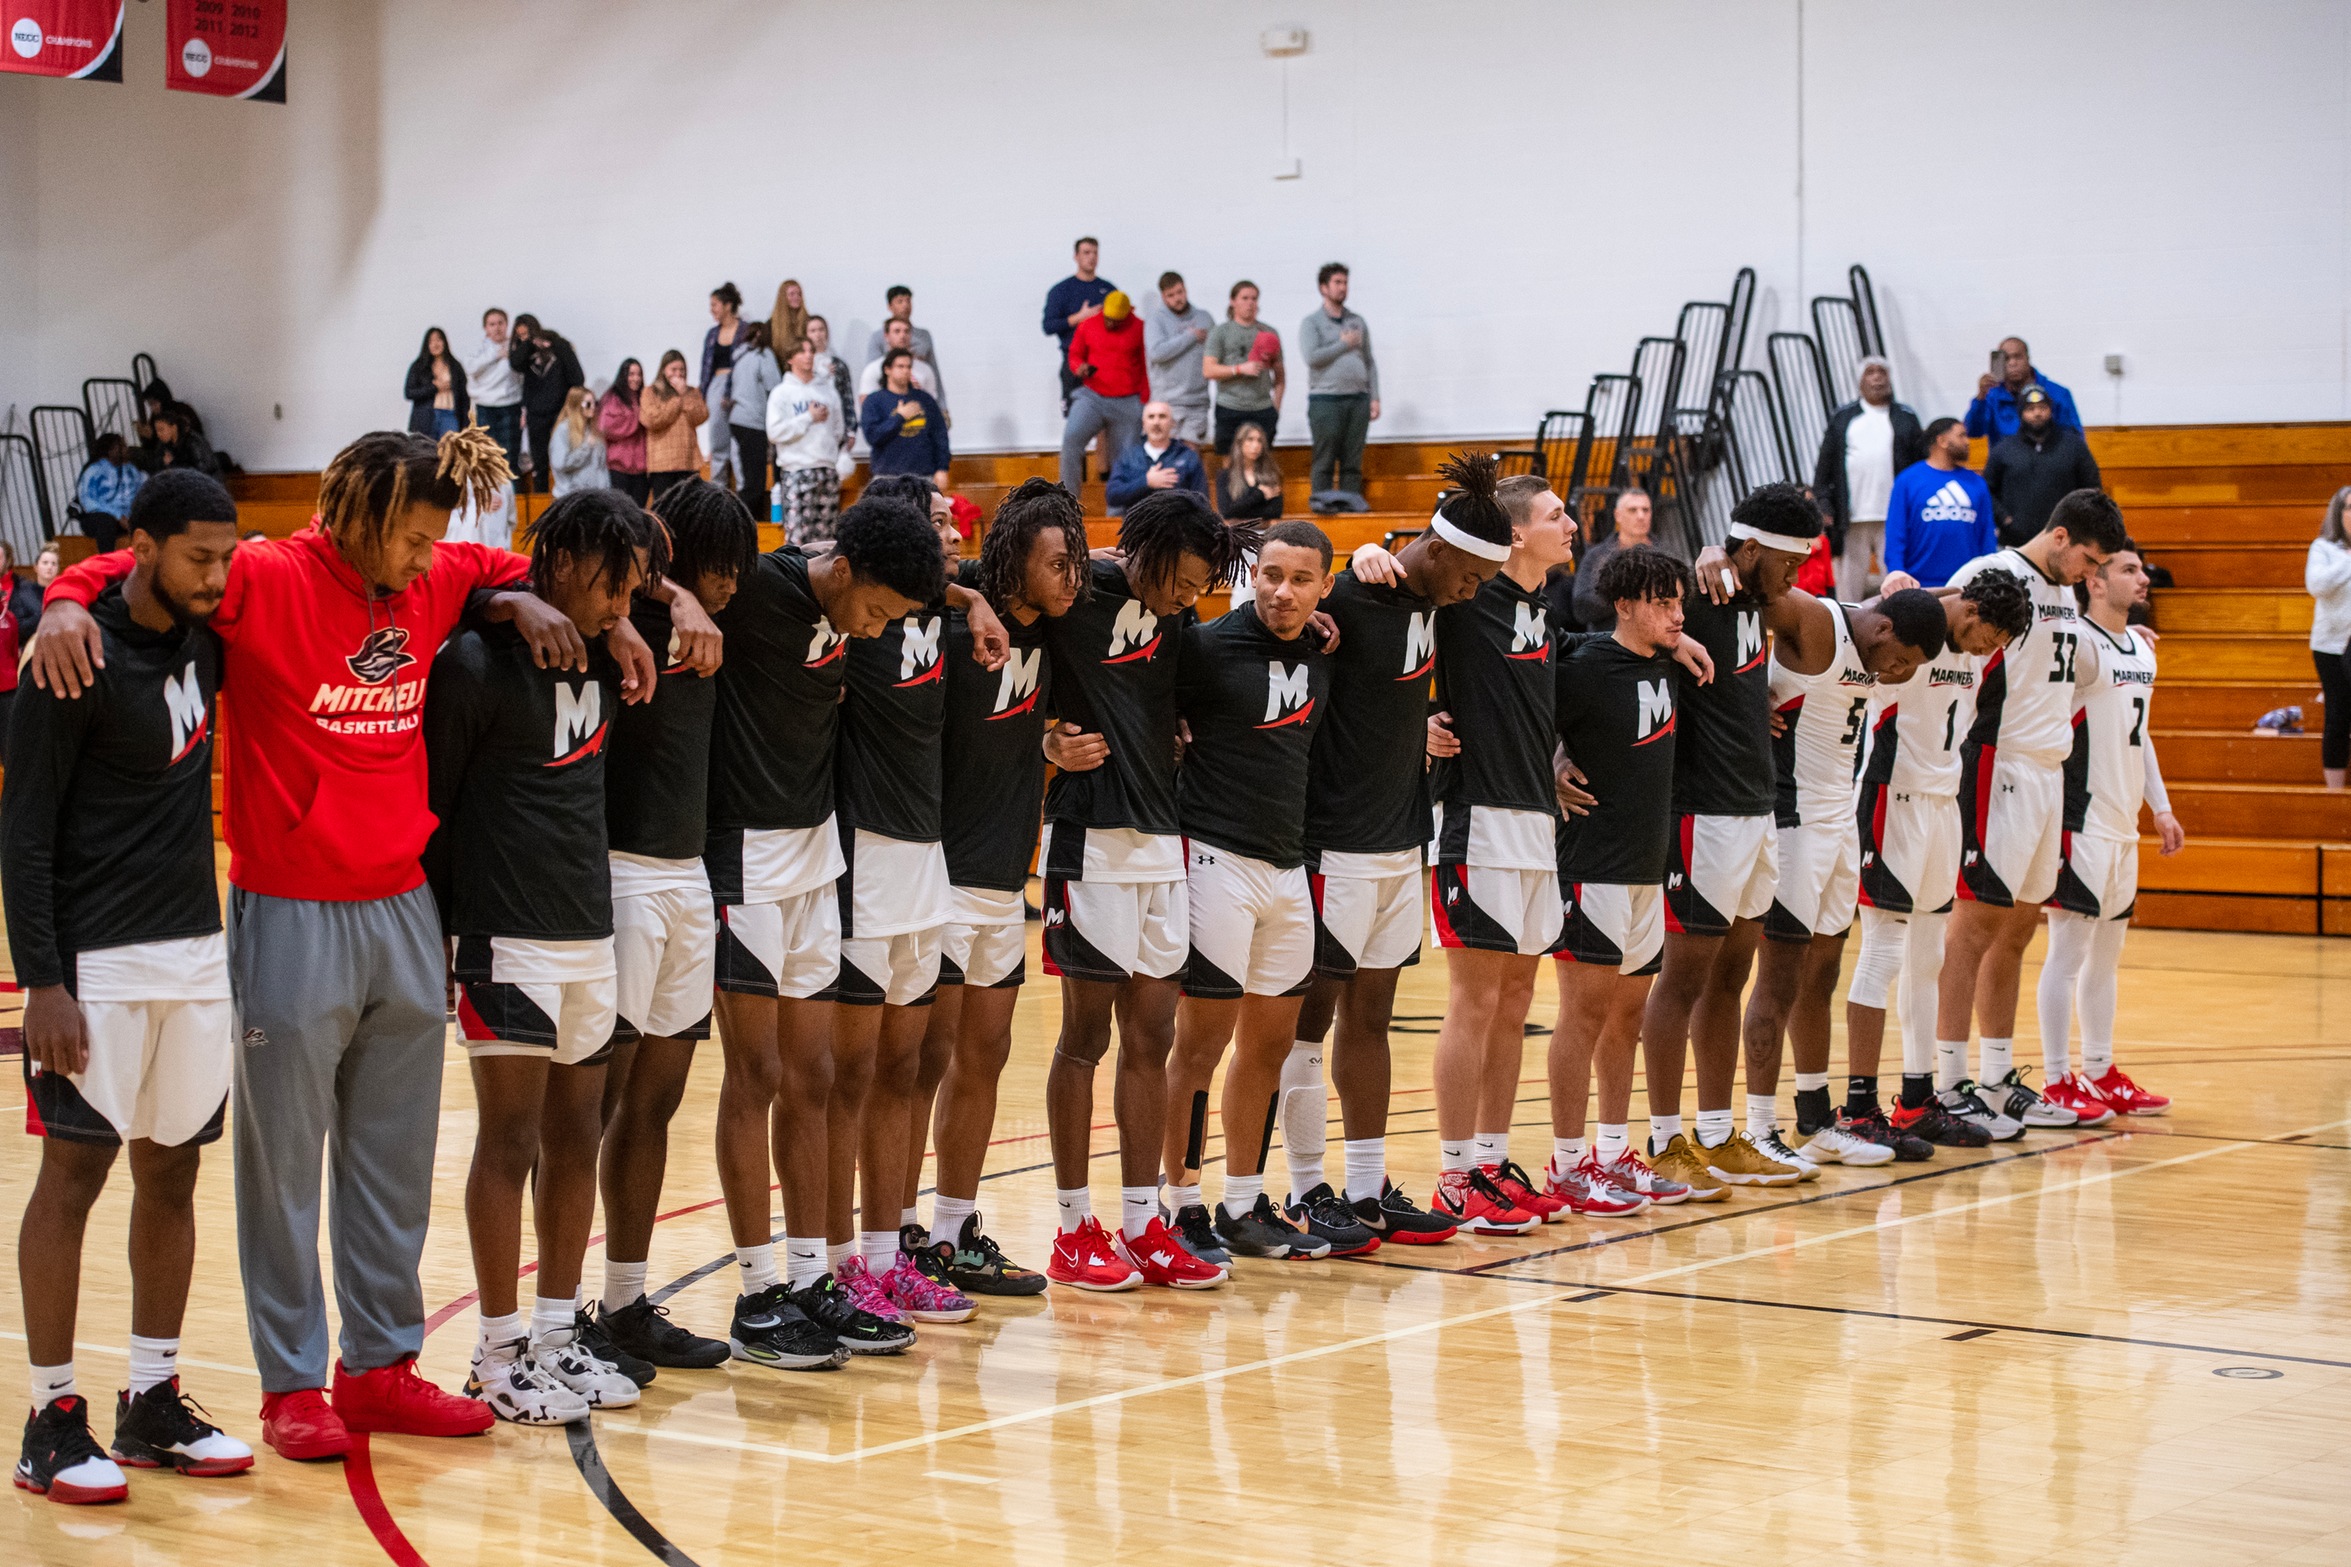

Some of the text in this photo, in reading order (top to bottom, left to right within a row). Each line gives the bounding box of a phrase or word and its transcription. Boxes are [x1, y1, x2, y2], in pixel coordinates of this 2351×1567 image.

[195, 17, 259, 38] 2011 2012
[231, 3, 260, 19] 2010
[14, 32, 40, 43] NECC
[184, 52, 208, 63] NECC
[1921, 504, 1977, 524] adidas
[1108, 599, 1157, 657] M
[1511, 600, 1547, 652] M
[2038, 604, 2076, 620] MARINERS
[901, 616, 942, 680] M
[1402, 610, 1436, 674] M
[1737, 611, 1762, 668] M
[2048, 631, 2078, 683] 32
[993, 647, 1041, 714] M
[1264, 660, 1309, 723] M
[1839, 665, 1879, 686] MARIN
[1929, 667, 1974, 686] MARINERS
[2113, 669, 2153, 684] MARINERS
[164, 660, 206, 761] M
[553, 680, 600, 759] M
[1637, 678, 1672, 740] M
[1840, 697, 1867, 744] 5
[1943, 699, 1958, 751] 1
[1668, 871, 1683, 890] M
[1964, 850, 1978, 866] M
[1045, 907, 1065, 928] M
